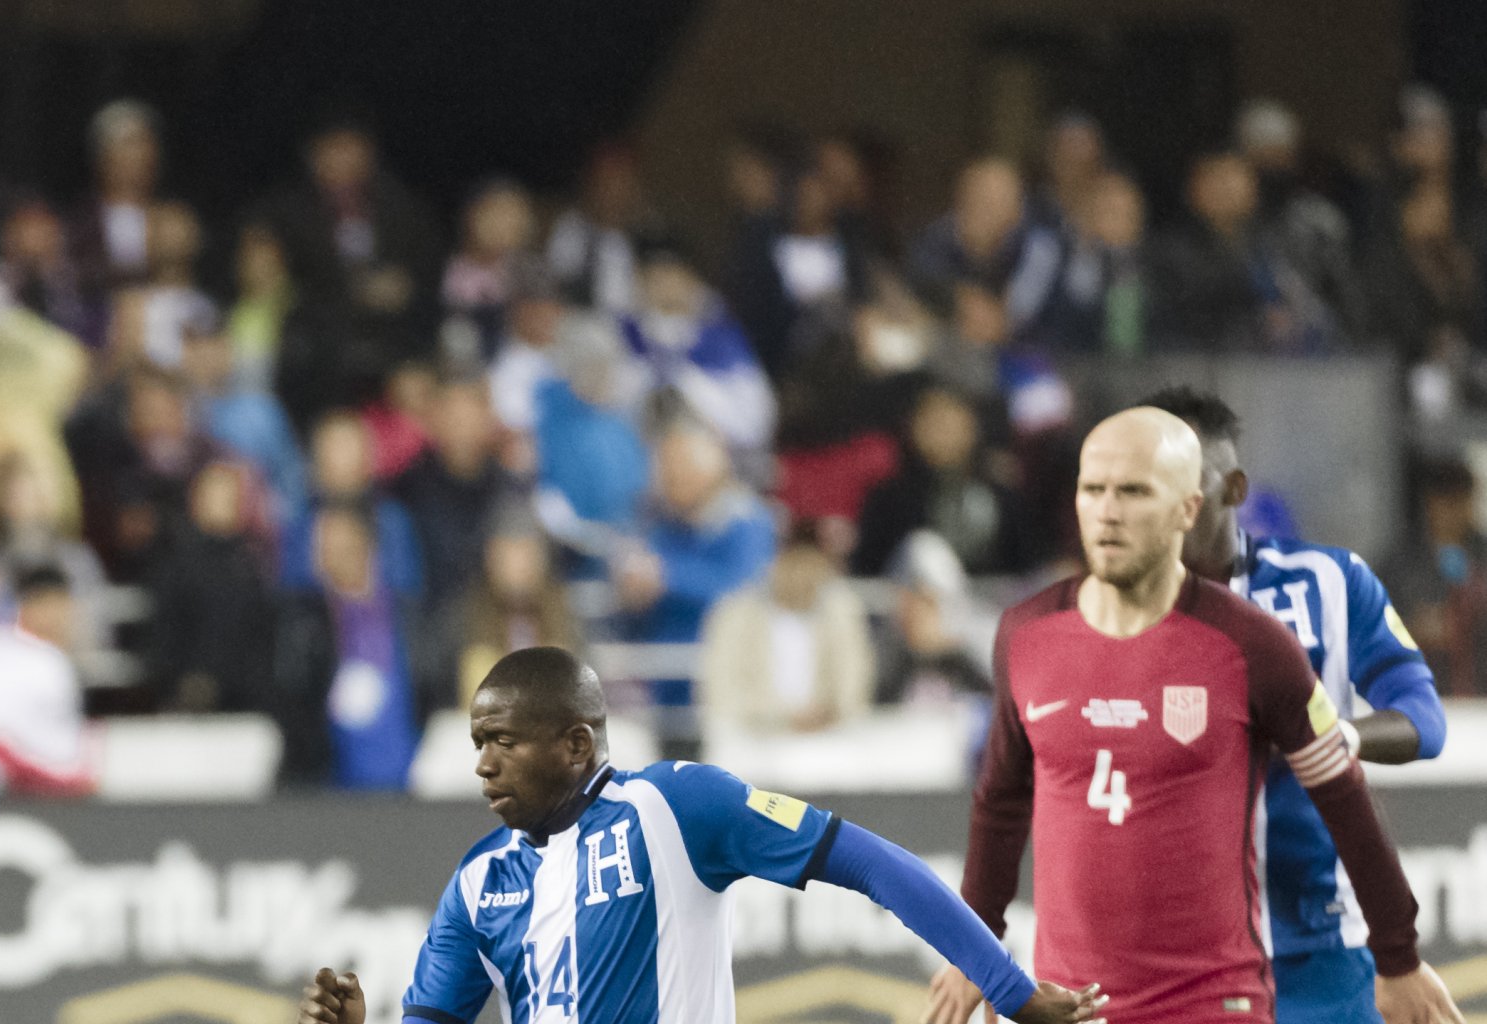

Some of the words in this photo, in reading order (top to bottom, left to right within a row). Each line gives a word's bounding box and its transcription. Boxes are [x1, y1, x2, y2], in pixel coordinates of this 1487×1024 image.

[1087, 749, 1132, 825] 4
[585, 819, 644, 906] H
[523, 936, 578, 1019] 14
